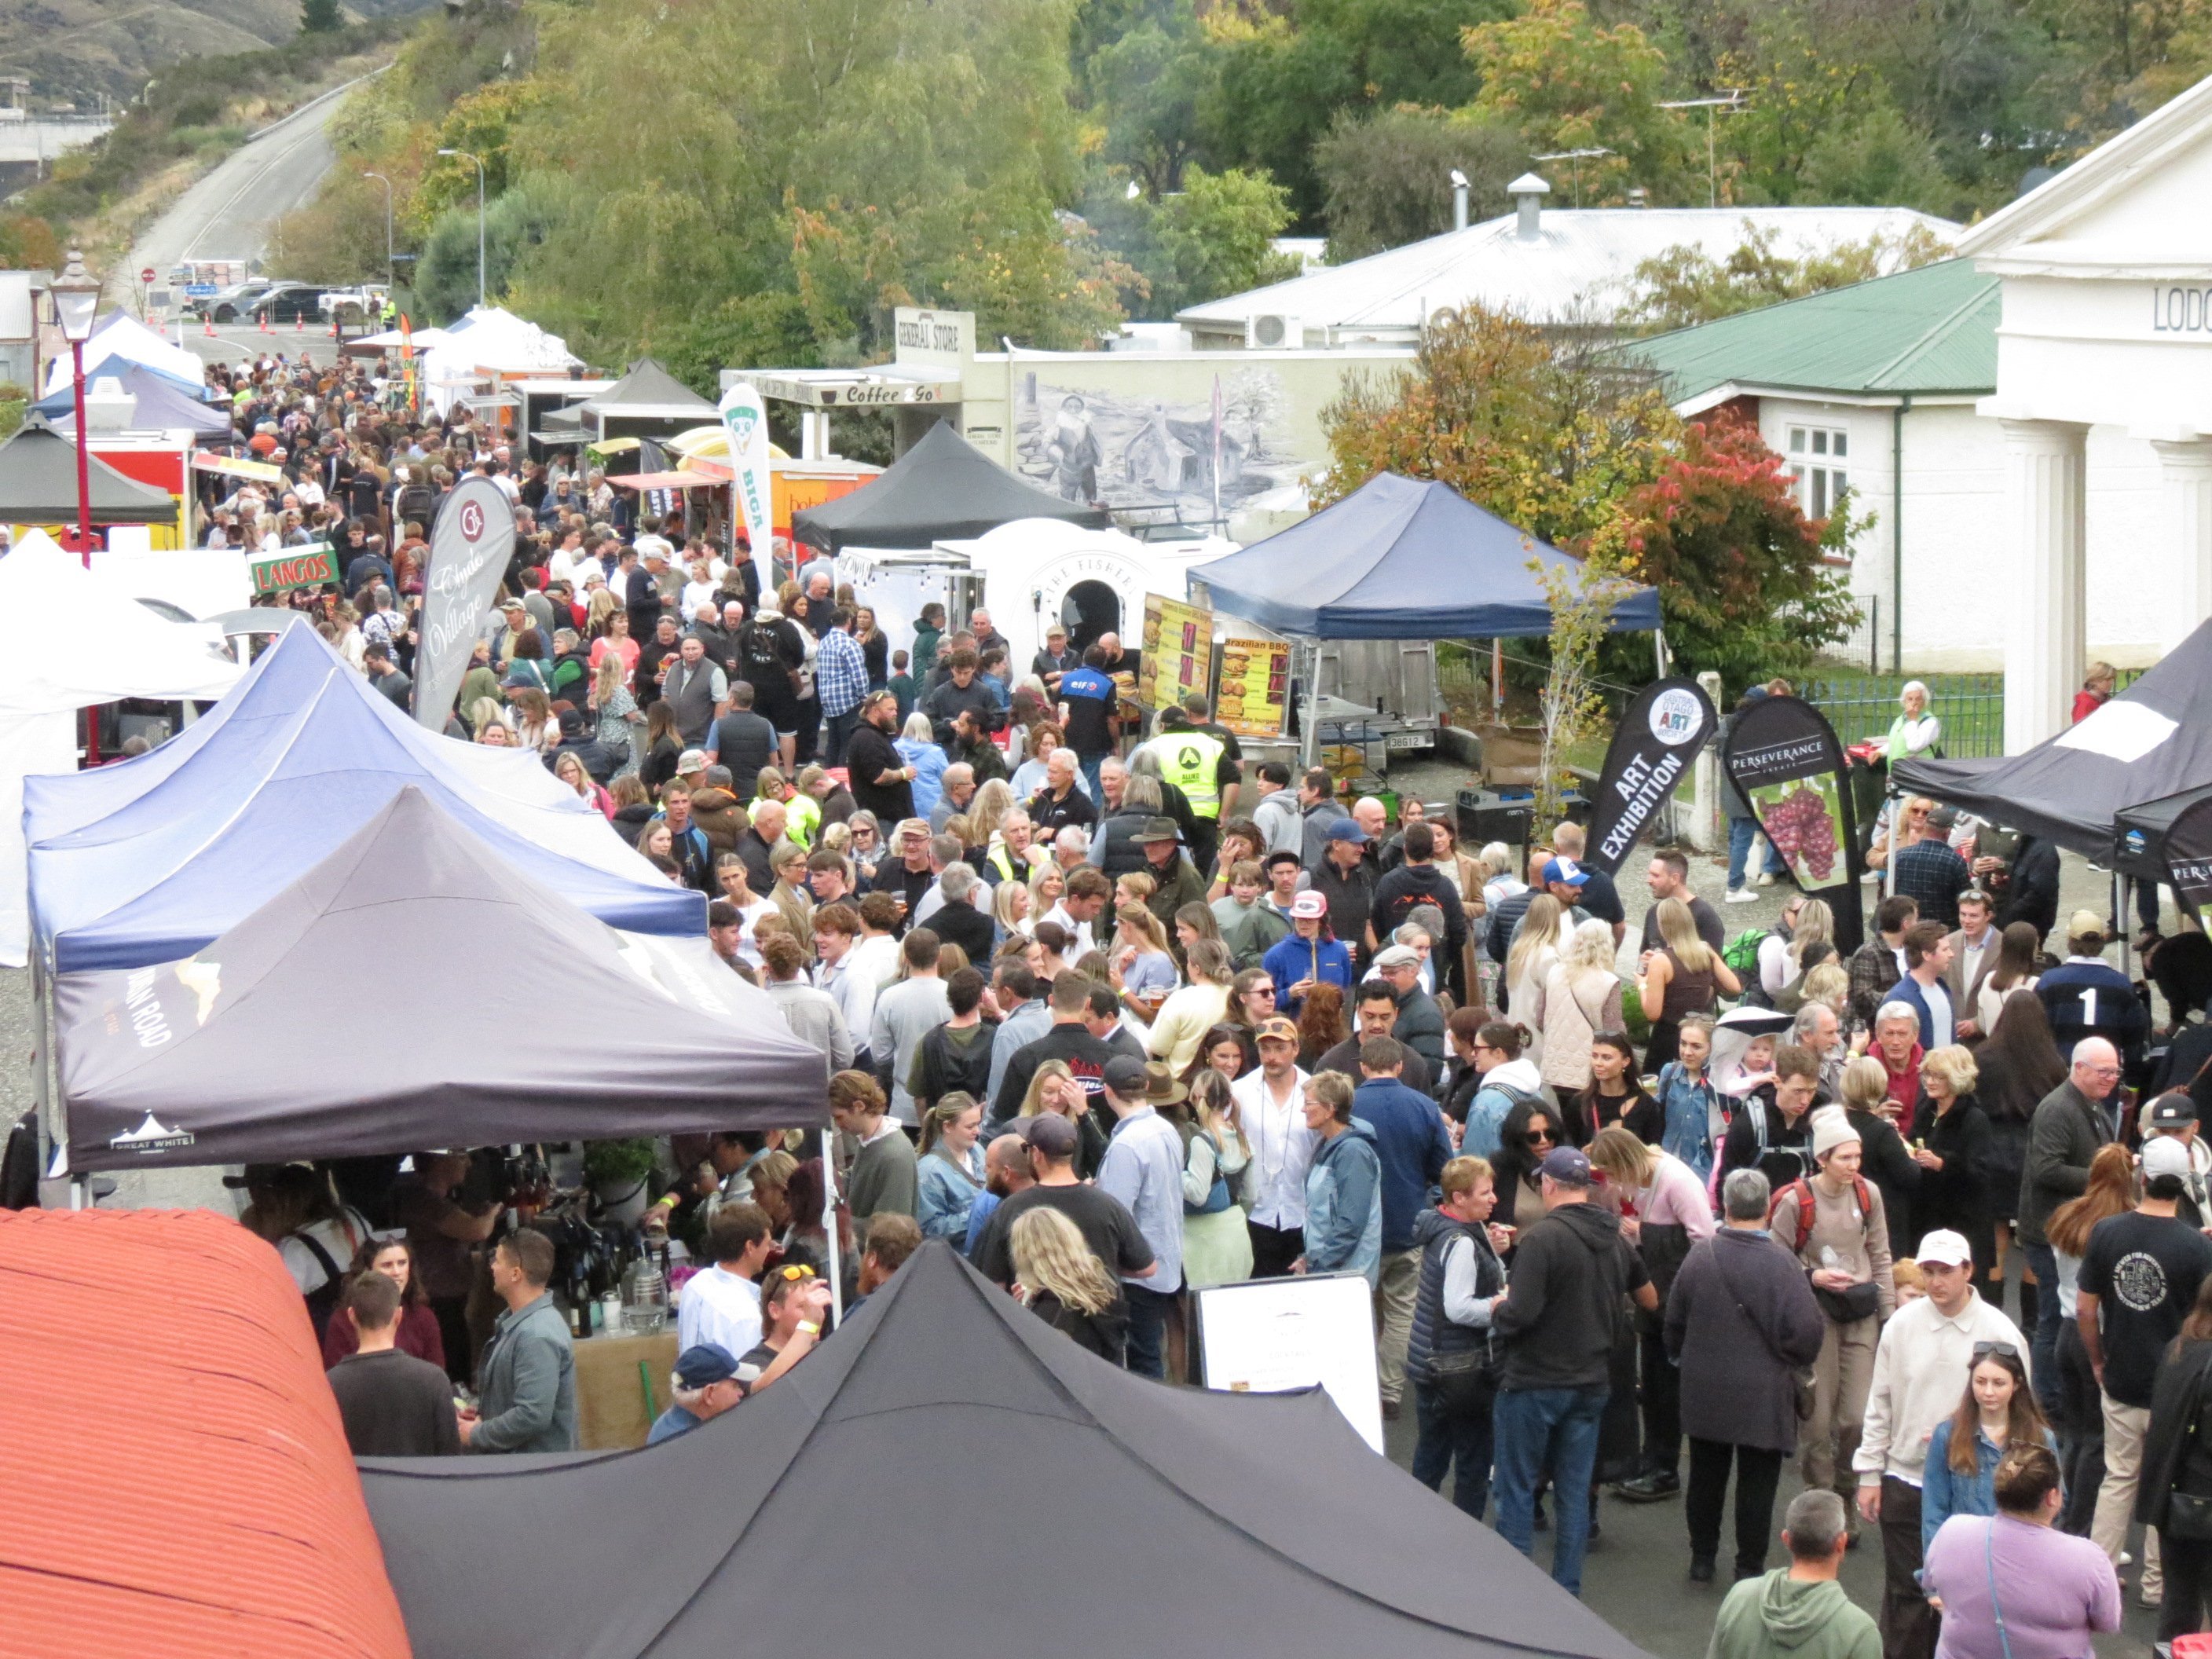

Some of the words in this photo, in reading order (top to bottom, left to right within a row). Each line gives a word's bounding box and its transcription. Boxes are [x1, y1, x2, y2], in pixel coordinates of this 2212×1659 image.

[899, 321, 929, 349] GENERAL
[933, 324, 958, 352] STORE
[847, 386, 899, 403] Coffee
[904, 387, 915, 402] 2
[915, 385, 933, 401] Go
[742, 468, 764, 531] BIGA
[256, 553, 331, 591] LANGOS
[432, 548, 485, 598] Clyde
[1046, 566, 1071, 595] THE
[429, 593, 482, 657] Village
[1225, 639, 1266, 650] Brazilian
[1269, 642, 1290, 652] BBQ
[1662, 701, 1694, 716] OTAGO
[1664, 694, 1694, 707] CENTRAL
[1216, 714, 1253, 723] Homemade
[1659, 712, 1692, 731] ART
[1390, 736, 1419, 748] 38G12
[1656, 727, 1687, 741] SOCIETY
[1732, 742, 1822, 769] PERSEVERANCE
[1615, 753, 1652, 802] ART
[1600, 753, 1683, 860] EXHIBITION
[2078, 987, 2097, 1026] 1
[132, 1000, 173, 1048] ROAD
[115, 1141, 151, 1150] GREAT
[153, 1137, 189, 1148] WHITE
